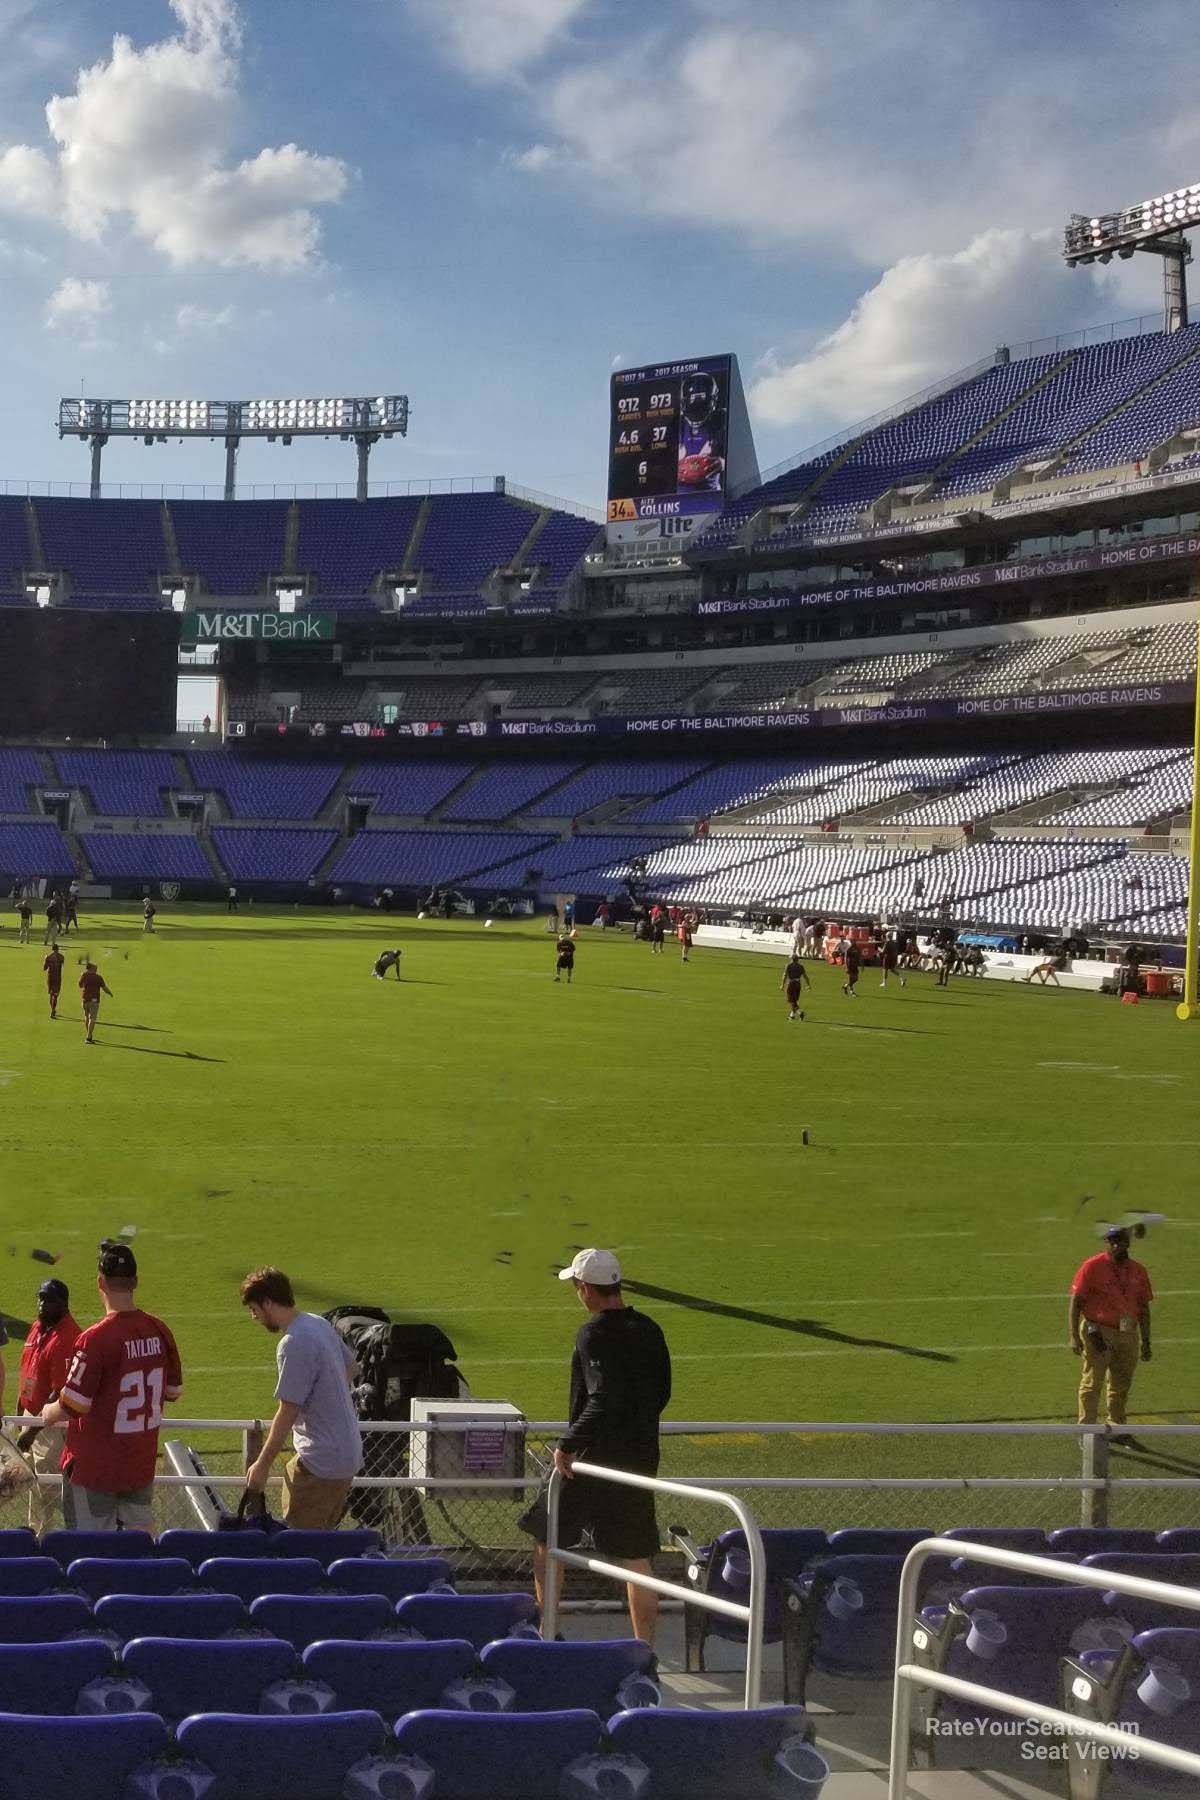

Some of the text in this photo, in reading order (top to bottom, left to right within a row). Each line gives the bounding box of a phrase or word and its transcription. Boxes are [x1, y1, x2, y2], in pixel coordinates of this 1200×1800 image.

[655, 363, 698, 377] 2017 SEASON
[650, 393, 672, 409] 973
[619, 426, 667, 445] 4.6 37
[638, 461, 647, 475] 6
[610, 501, 626, 519] 34
[640, 501, 680, 516] COLLINS
[659, 517, 694, 538] Lite
[1101, 549, 1136, 565] HOME
[1139, 546, 1157, 560] OF
[1160, 542, 1185, 556] THE
[994, 558, 1088, 582] M&T Bank Stadium
[801, 573, 981, 605] HOME OF THE BALTIMORE RAVENS
[698, 597, 790, 614] M&T Bank Stadium
[196, 613, 321, 638] M&T Bank
[957, 687, 1161, 714] HOME OF THE BALTIMORE RAVENS
[627, 712, 810, 732] HOME OF THE BALTIMORE RAVENS
[840, 705, 927, 723] M&T Bank Stadium
[501, 720, 596, 735] M&T Bank Stadium
[125, 1336, 161, 1360] TAYLOR
[114, 1367, 164, 1434] 21
